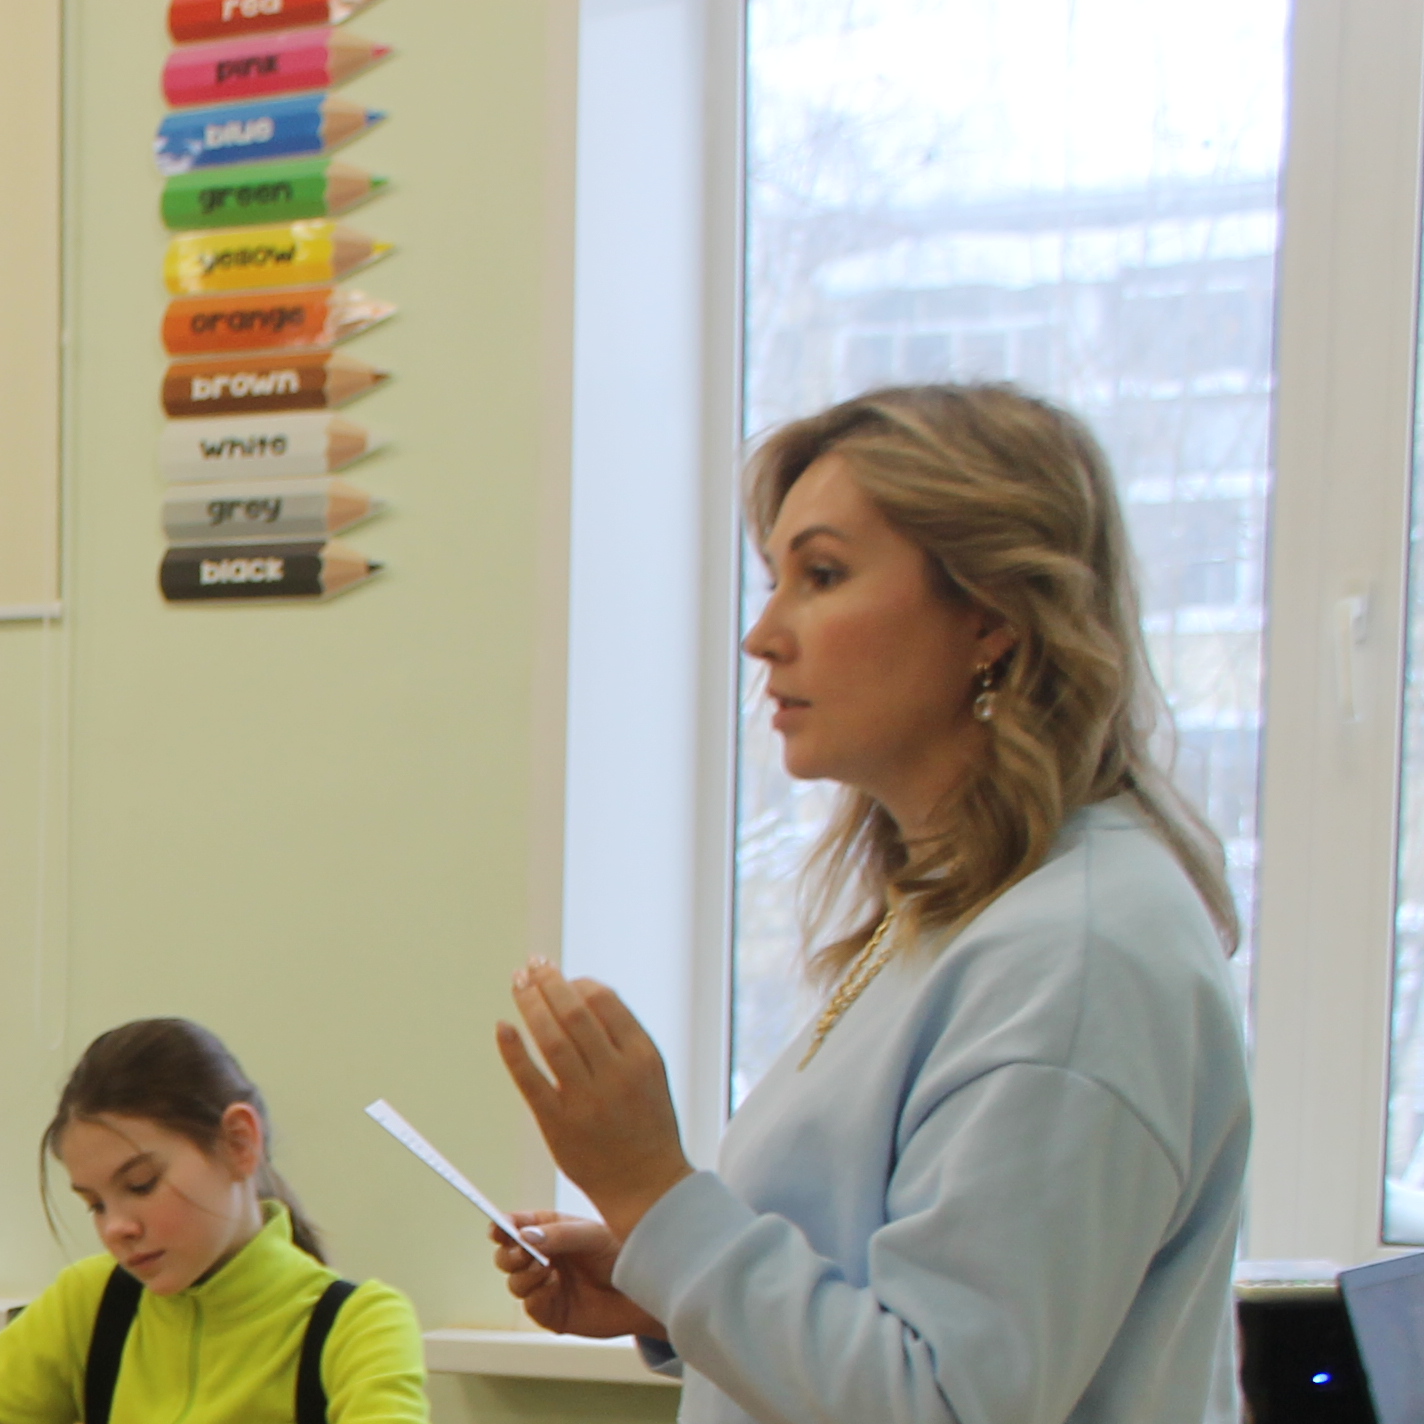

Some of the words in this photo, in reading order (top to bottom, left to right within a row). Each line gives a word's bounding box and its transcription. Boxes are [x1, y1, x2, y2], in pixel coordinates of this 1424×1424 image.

[204, 116, 275, 148] blue
[198, 181, 293, 214] green
[190, 305, 307, 334] orange
[191, 367, 299, 401] brown
[200, 434, 288, 459] white
[207, 496, 283, 526] grey
[199, 556, 284, 585] black
